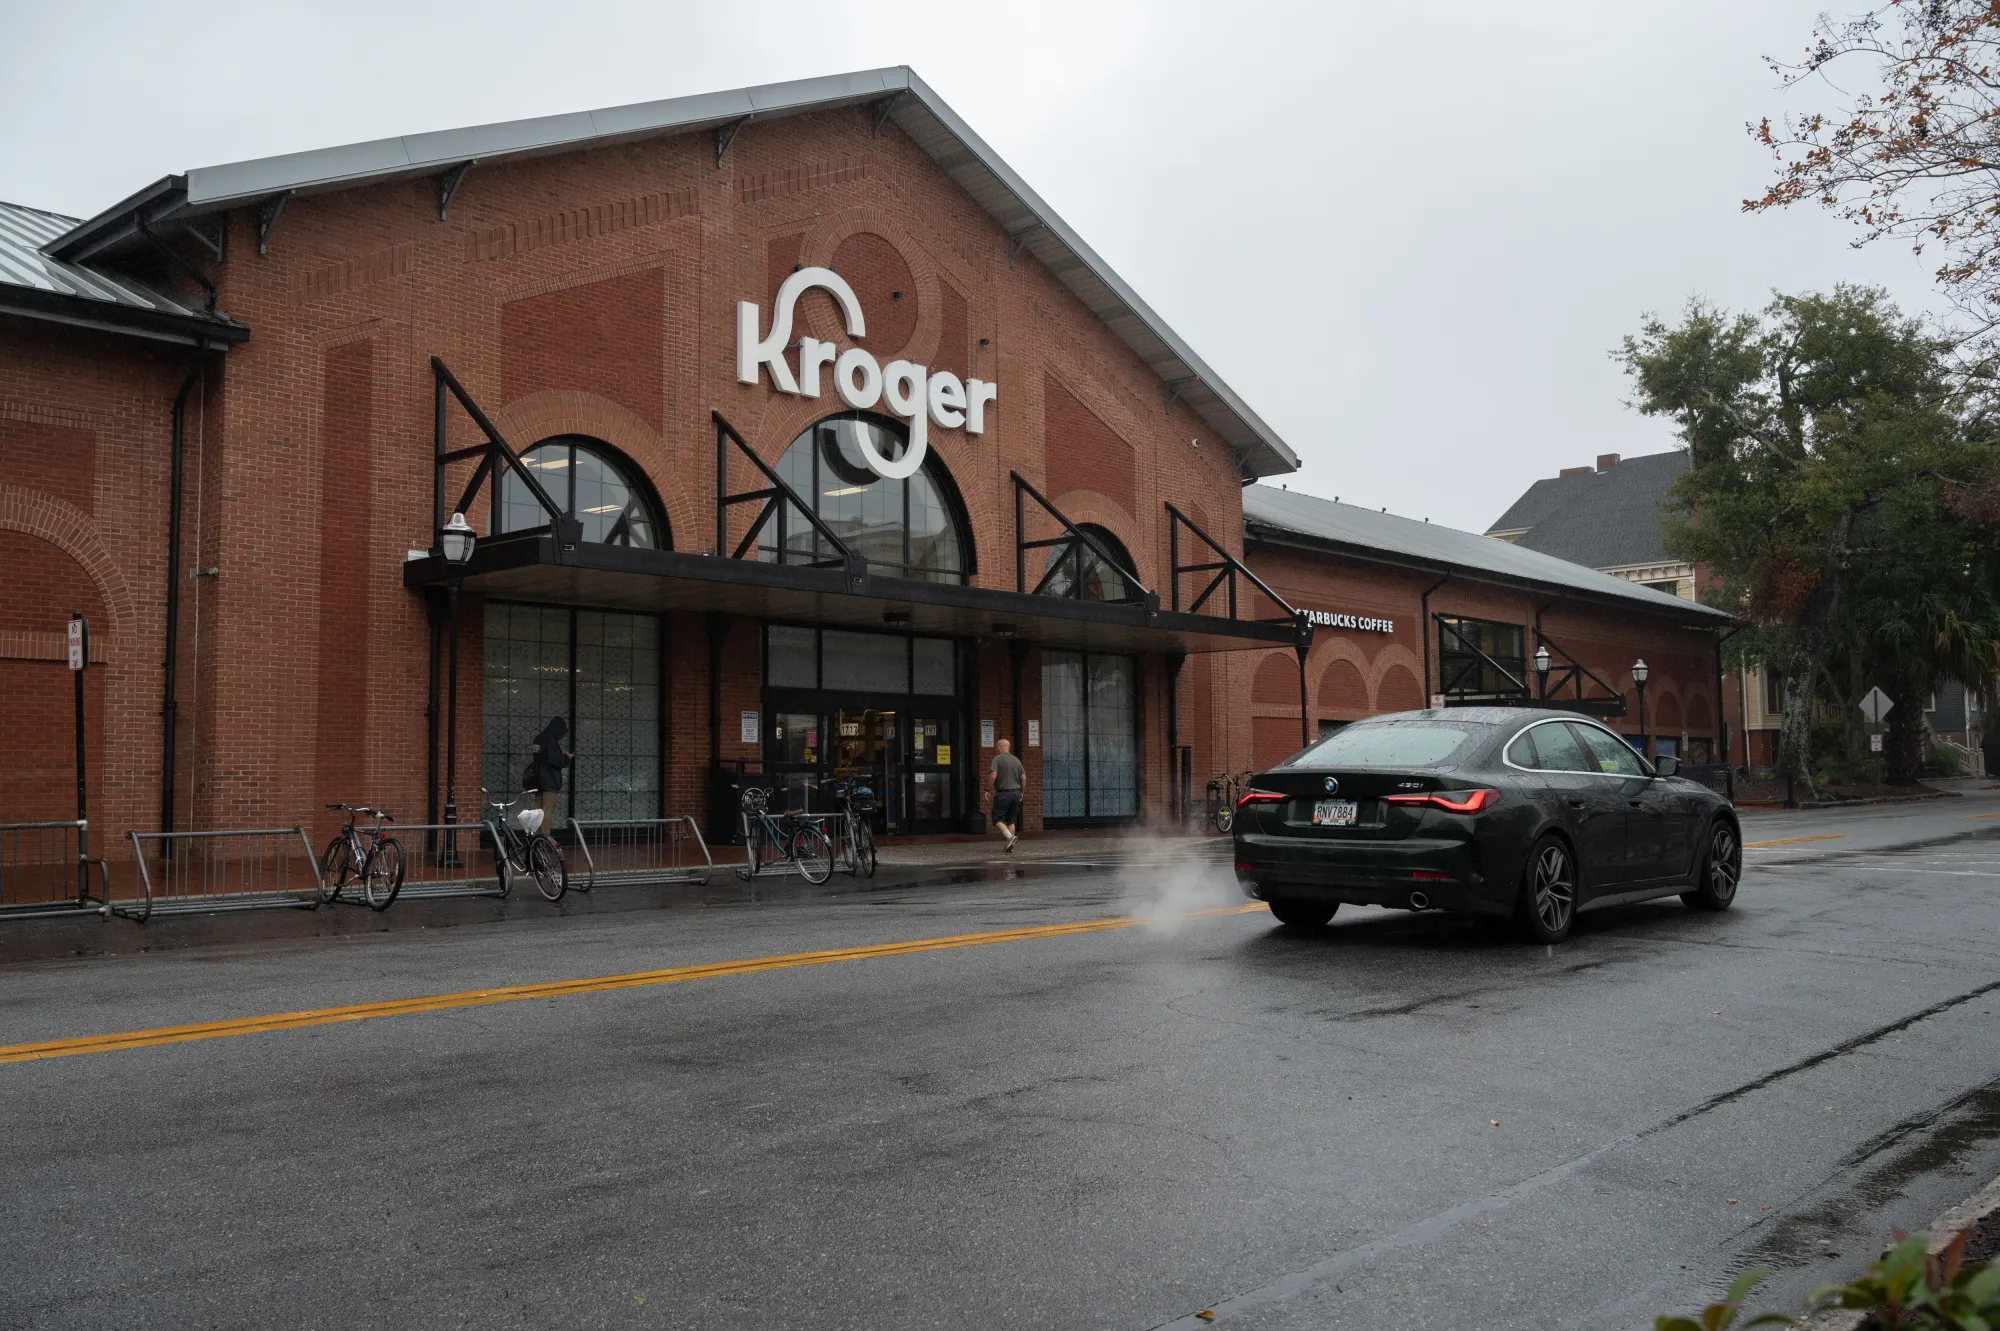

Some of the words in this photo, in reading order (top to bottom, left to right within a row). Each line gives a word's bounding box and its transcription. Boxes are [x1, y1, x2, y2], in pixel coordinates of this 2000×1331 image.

[737, 266, 997, 479] Kroger
[1358, 616, 1394, 633] COFFEE
[1316, 805, 1353, 819] RNV7884
